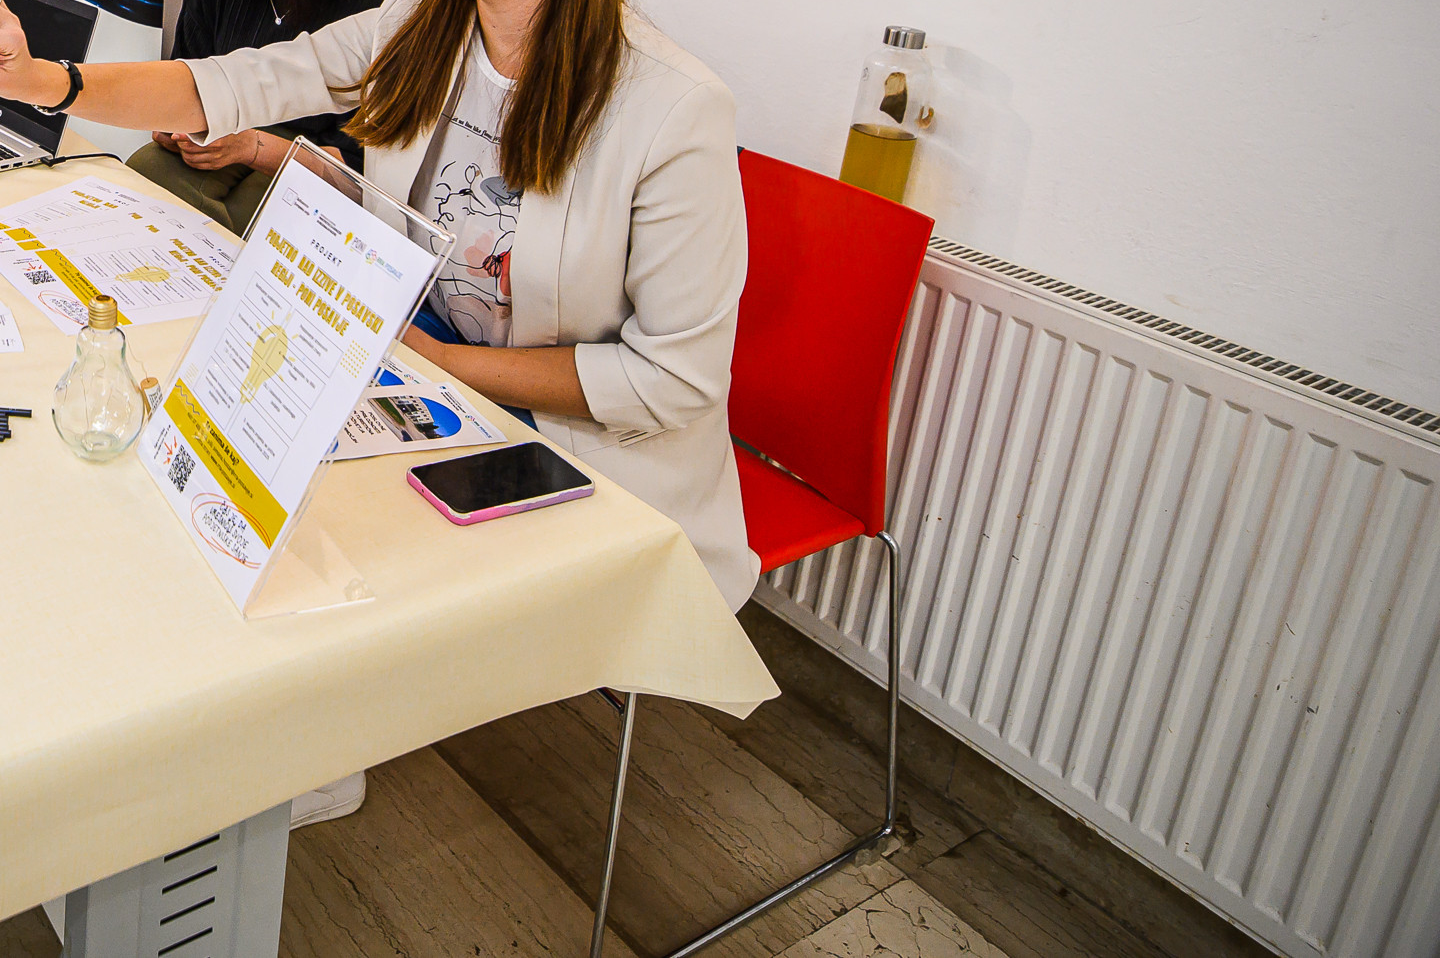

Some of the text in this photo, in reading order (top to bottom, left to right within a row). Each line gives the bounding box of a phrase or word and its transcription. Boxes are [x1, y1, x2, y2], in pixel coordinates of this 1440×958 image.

[265, 227, 300, 264] PODJETNO
[297, 255, 316, 278] NAD
[334, 285, 346, 302] V
[341, 291, 385, 336] POSAVSKI
[310, 238, 343, 268] PROJEKT
[270, 259, 295, 289] REGIJI
[295, 282, 317, 309] PONI
[312, 296, 350, 338] POSAVJE
[209, 428, 225, 449] zanima
[229, 451, 240, 466] kaj?
